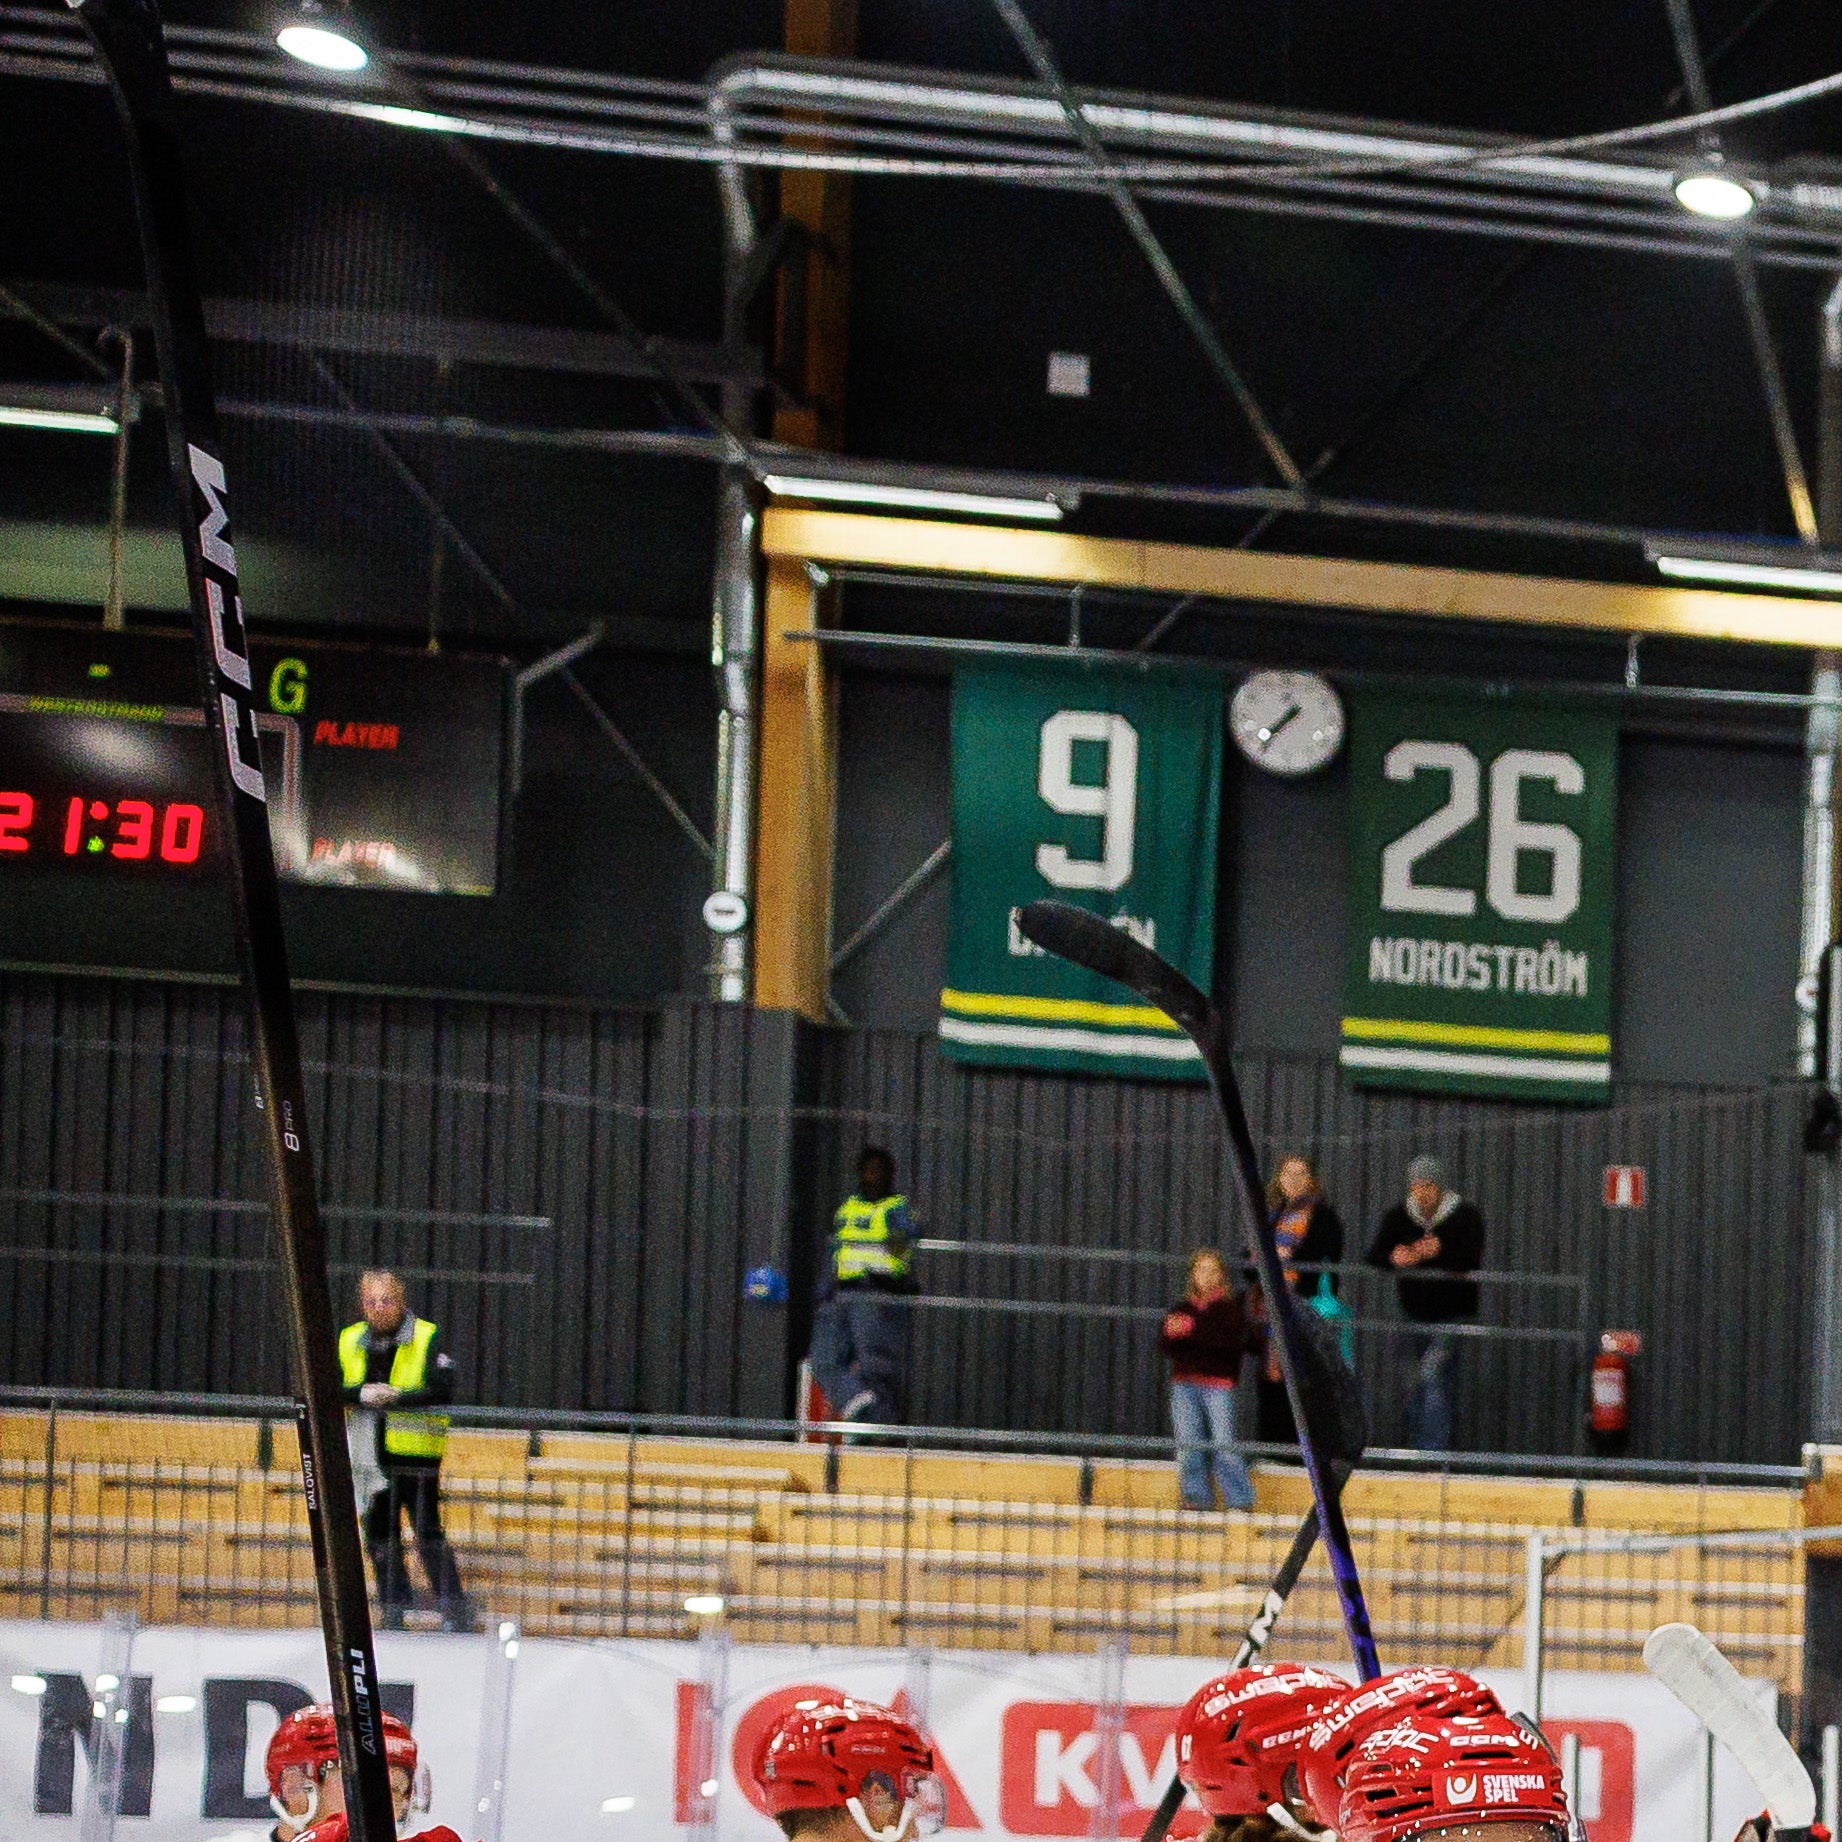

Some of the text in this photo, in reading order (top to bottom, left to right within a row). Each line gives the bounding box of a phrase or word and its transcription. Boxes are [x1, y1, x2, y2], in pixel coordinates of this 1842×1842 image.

[188, 442, 266, 801] CCM
[1036, 709, 1138, 891] 9
[1380, 739, 1584, 924] 26
[1368, 937, 1588, 998] NORDSTRÖM
[1482, 1774, 1545, 1792] SVENSKA
[1484, 1788, 1519, 1804] SPEL
